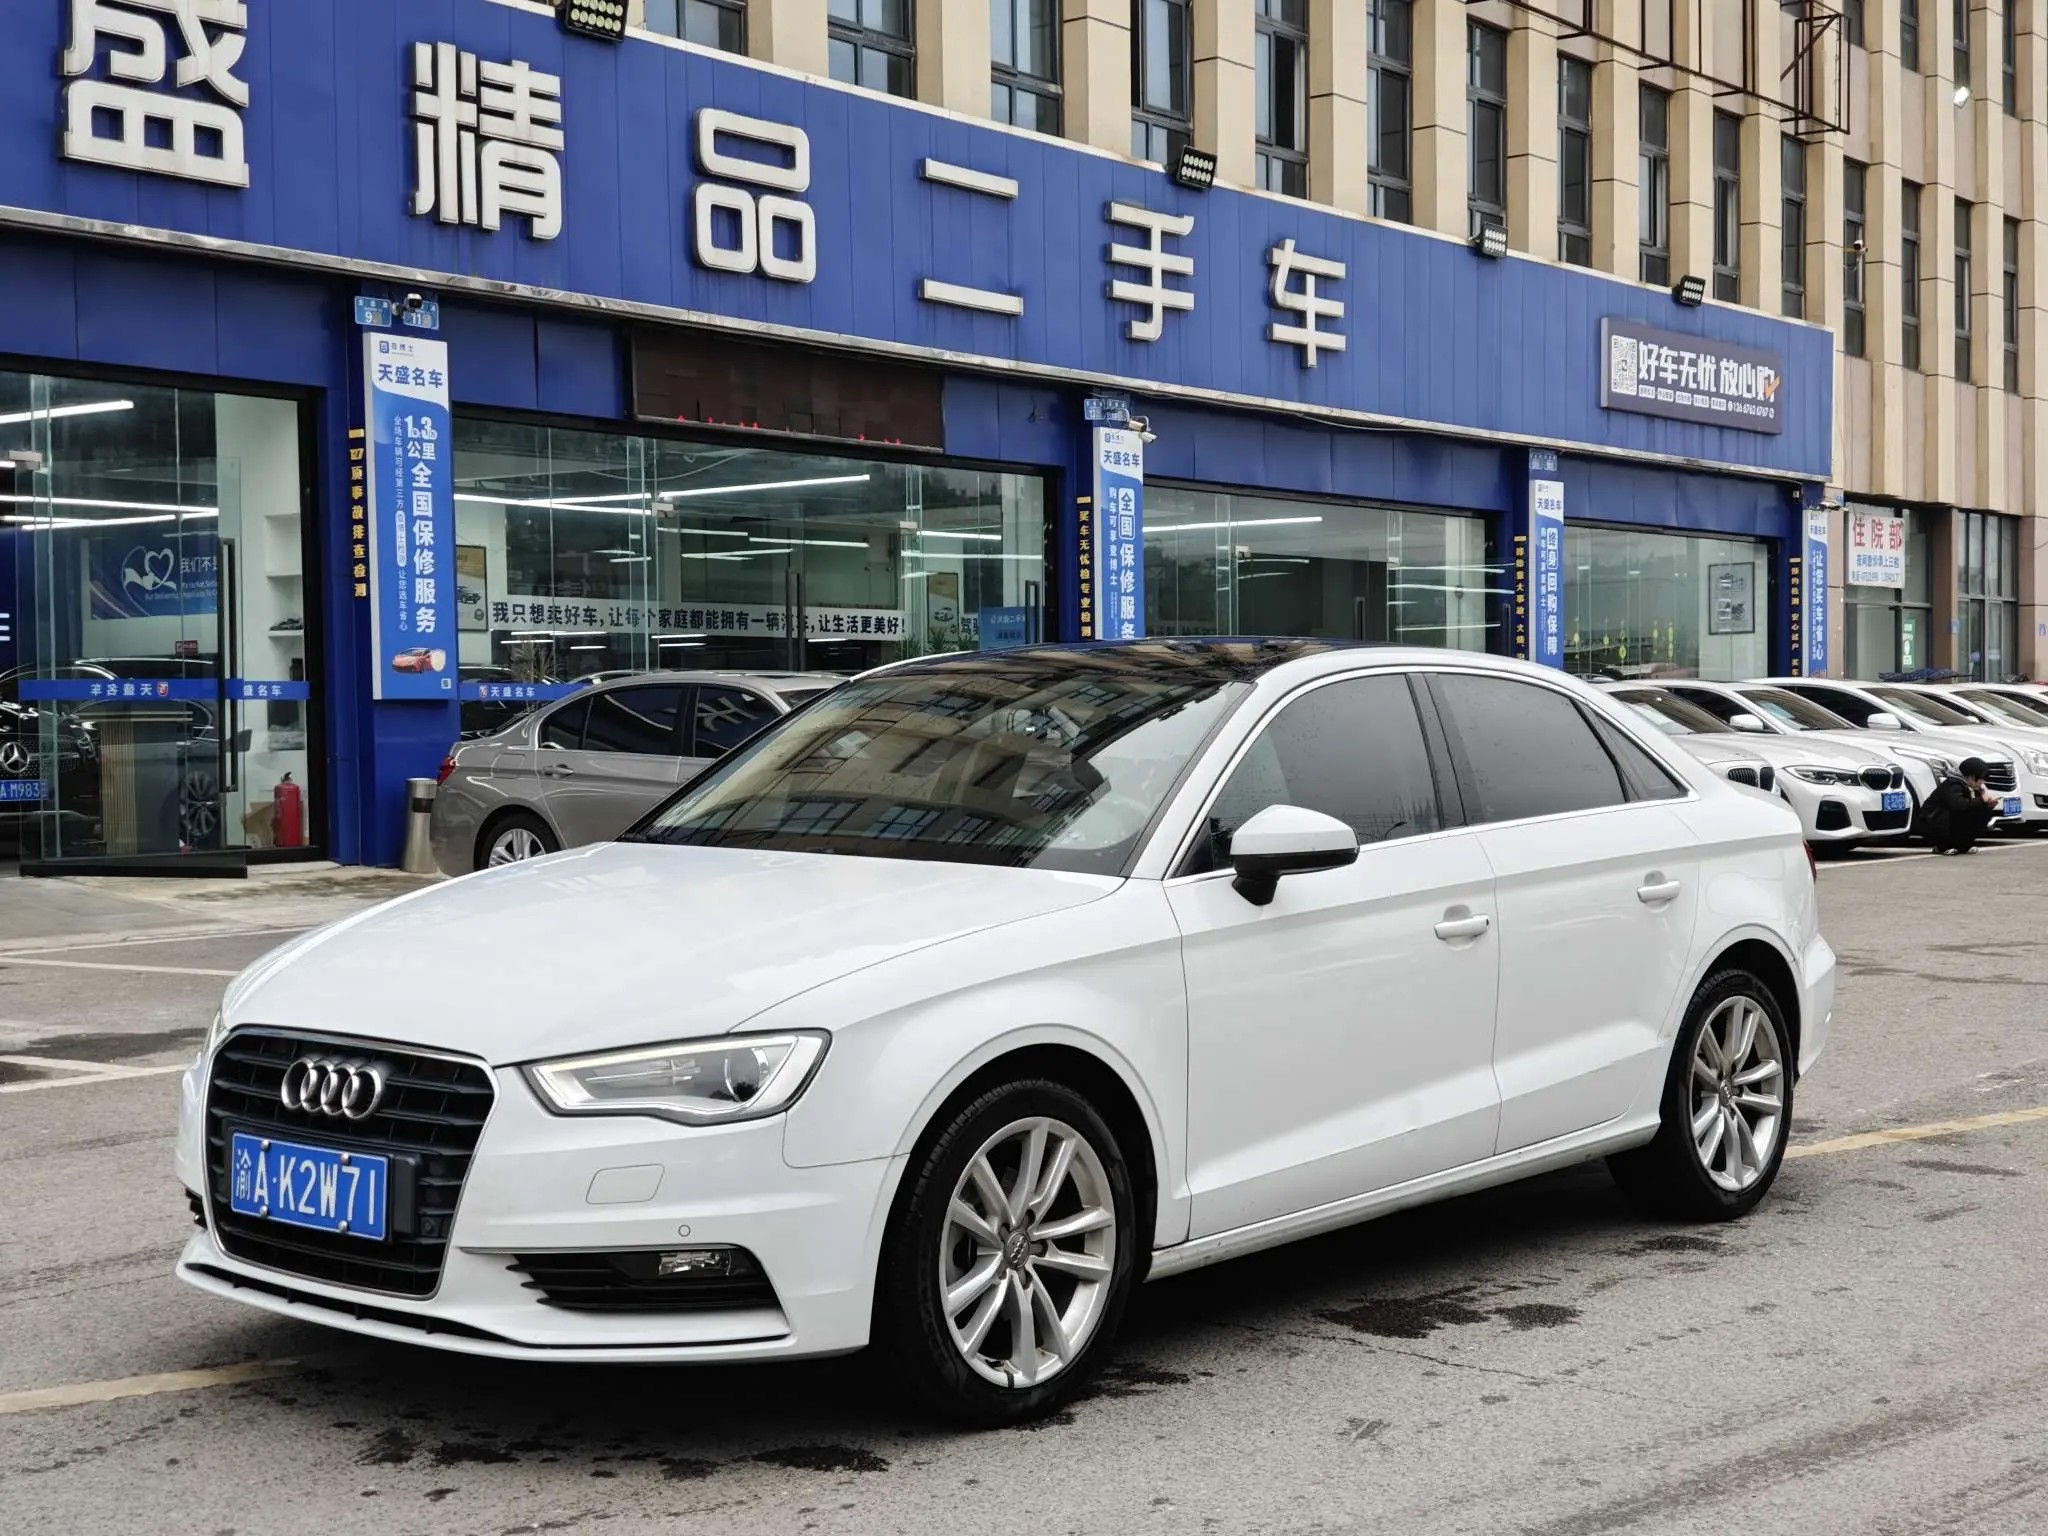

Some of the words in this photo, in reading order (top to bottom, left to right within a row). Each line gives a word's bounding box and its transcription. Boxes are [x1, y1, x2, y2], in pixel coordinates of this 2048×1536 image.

[378, 363, 443, 388] 天盛名车
[1638, 340, 1717, 393] 好车无忧
[1719, 358, 1775, 403] 放心购
[407, 441, 436, 461] 公里
[1103, 449, 1140, 468] 天盛名车
[1853, 516, 1904, 551] 住院部
[411, 460, 437, 633] 全国保修服务
[180, 556, 218, 573] 我们不
